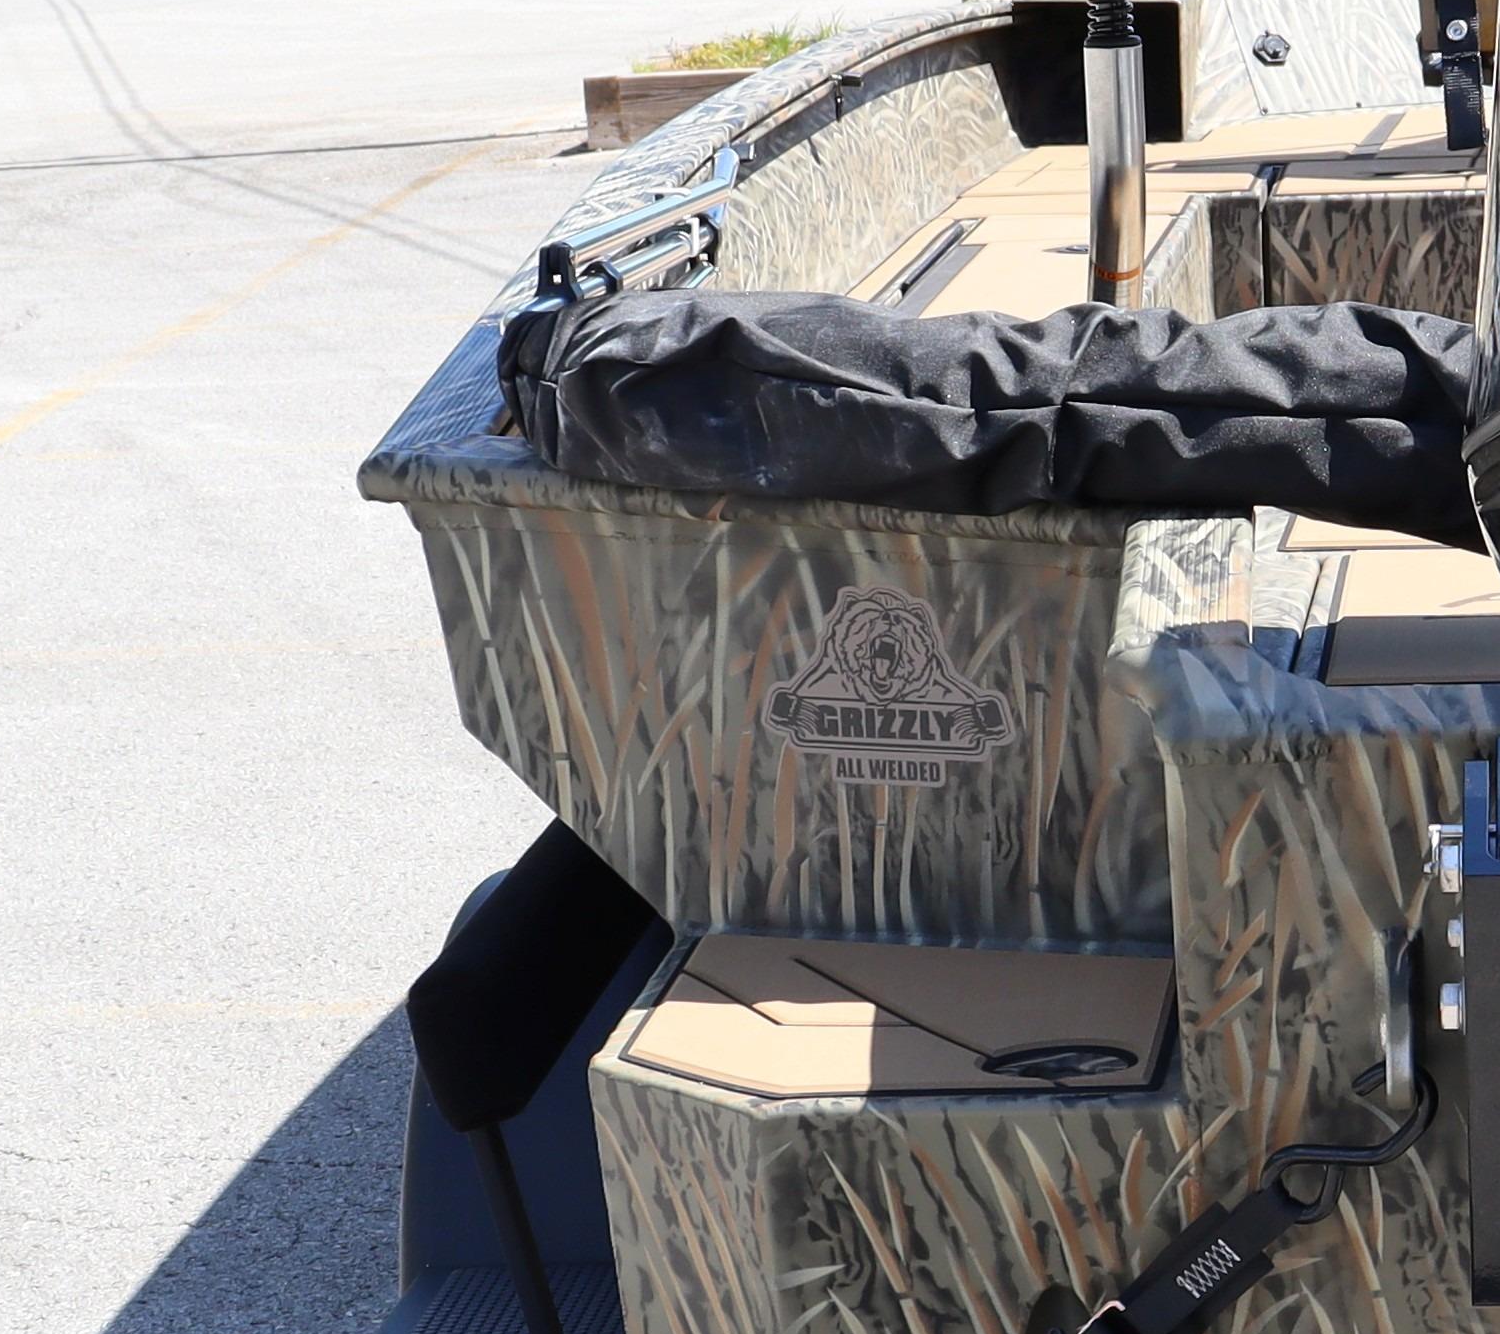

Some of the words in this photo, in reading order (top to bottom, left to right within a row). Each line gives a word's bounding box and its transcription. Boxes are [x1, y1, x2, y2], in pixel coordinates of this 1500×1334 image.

[816, 704, 955, 742] GRIZZLY
[836, 757, 866, 779] ALL
[868, 758, 941, 783] WELDED
